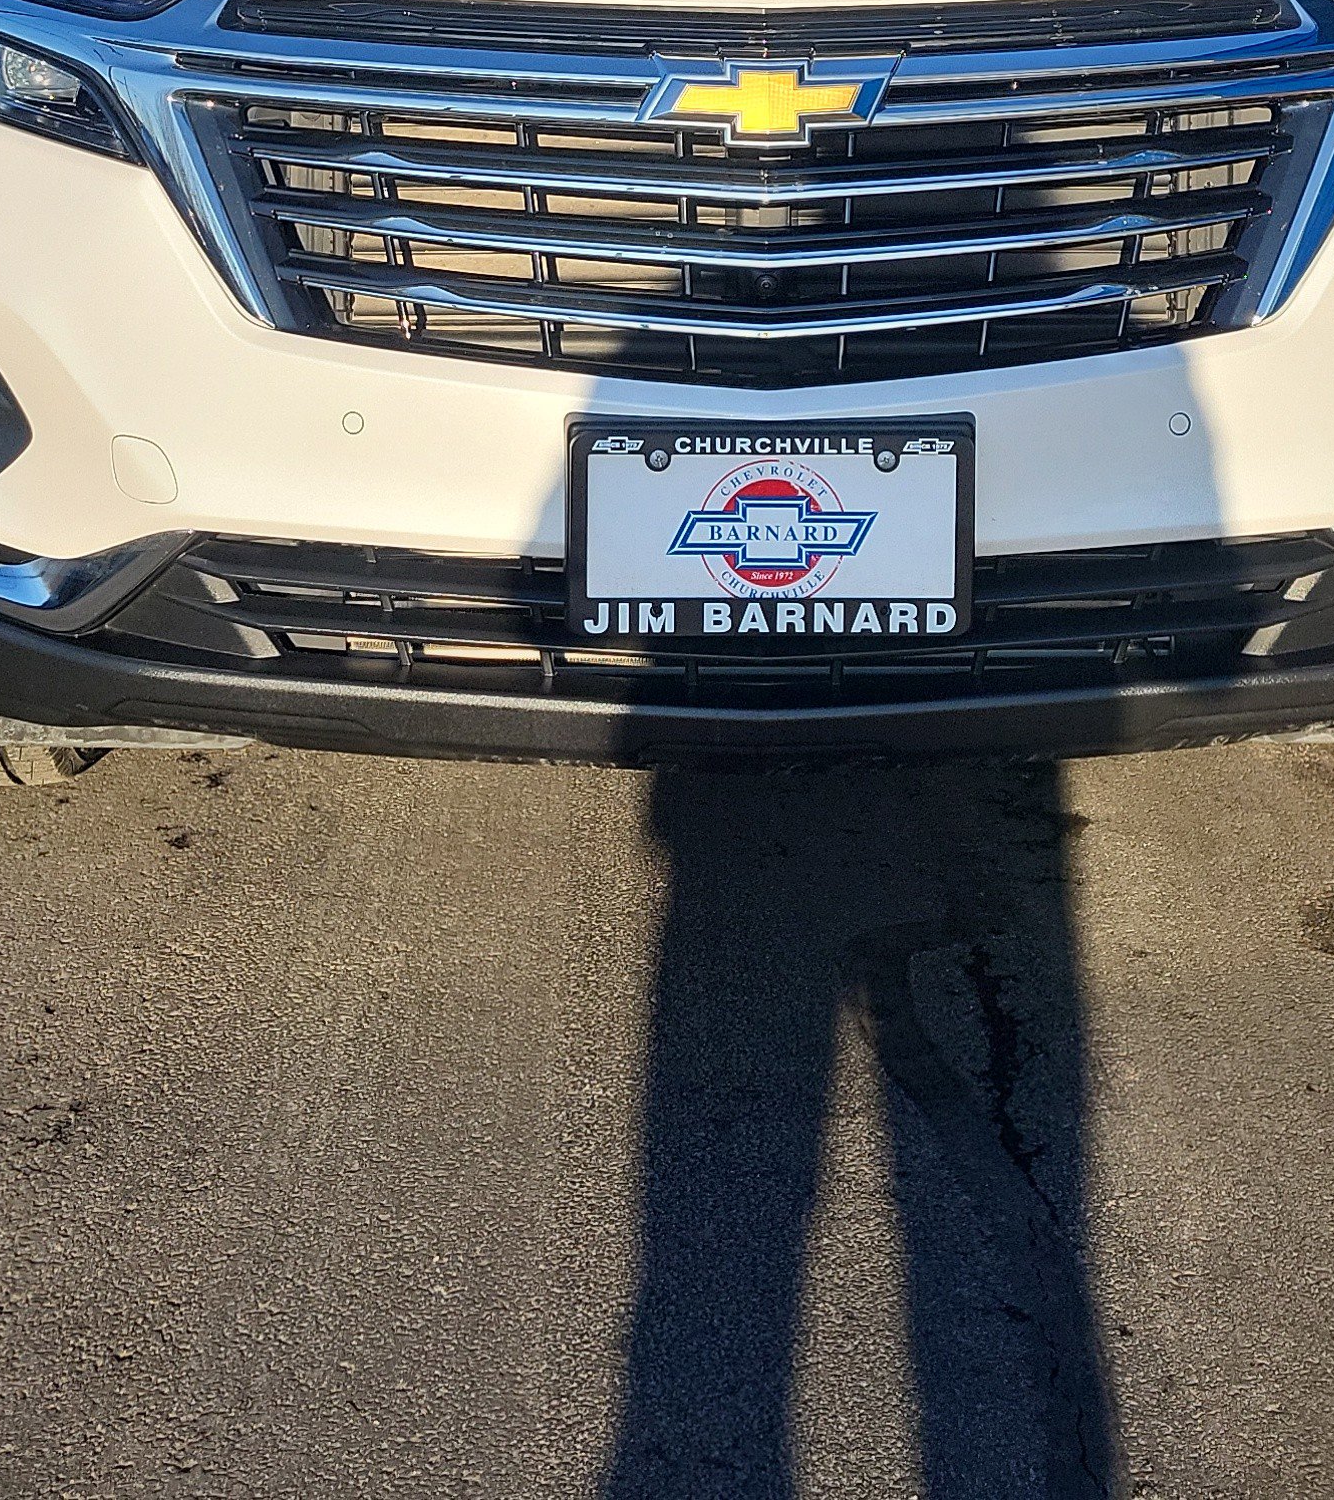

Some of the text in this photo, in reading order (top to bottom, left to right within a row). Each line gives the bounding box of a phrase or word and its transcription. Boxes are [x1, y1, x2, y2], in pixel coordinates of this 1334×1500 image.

[674, 437, 874, 454] CHURCHVILLE
[720, 466, 828, 497] CHEVROLET
[709, 525, 838, 541] BARNARD
[721, 570, 825, 598] CHURCHVILLE
[751, 571, 794, 580] Since 1972
[584, 602, 957, 633] JIM BARNARD
